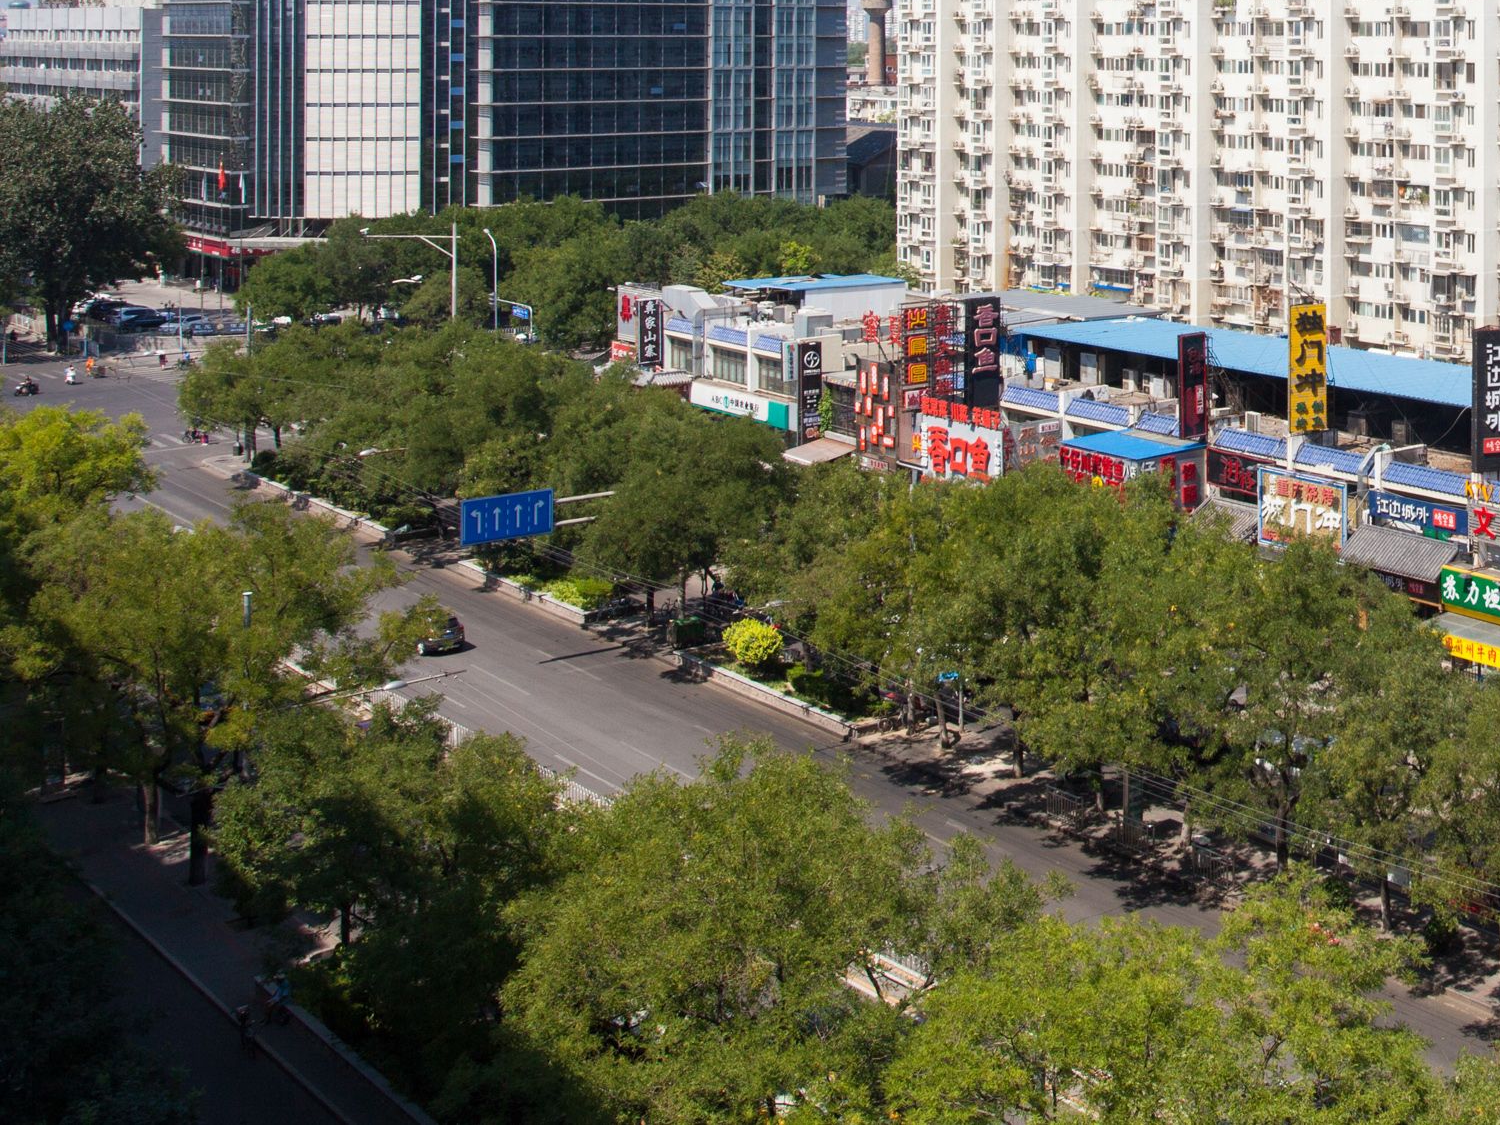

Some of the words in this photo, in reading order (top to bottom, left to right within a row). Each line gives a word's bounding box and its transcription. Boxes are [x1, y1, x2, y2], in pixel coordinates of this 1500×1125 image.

[972, 303, 999, 375] 香口鱼
[927, 426, 992, 485] 香口鱼
[1376, 496, 1430, 524] 江边城外
